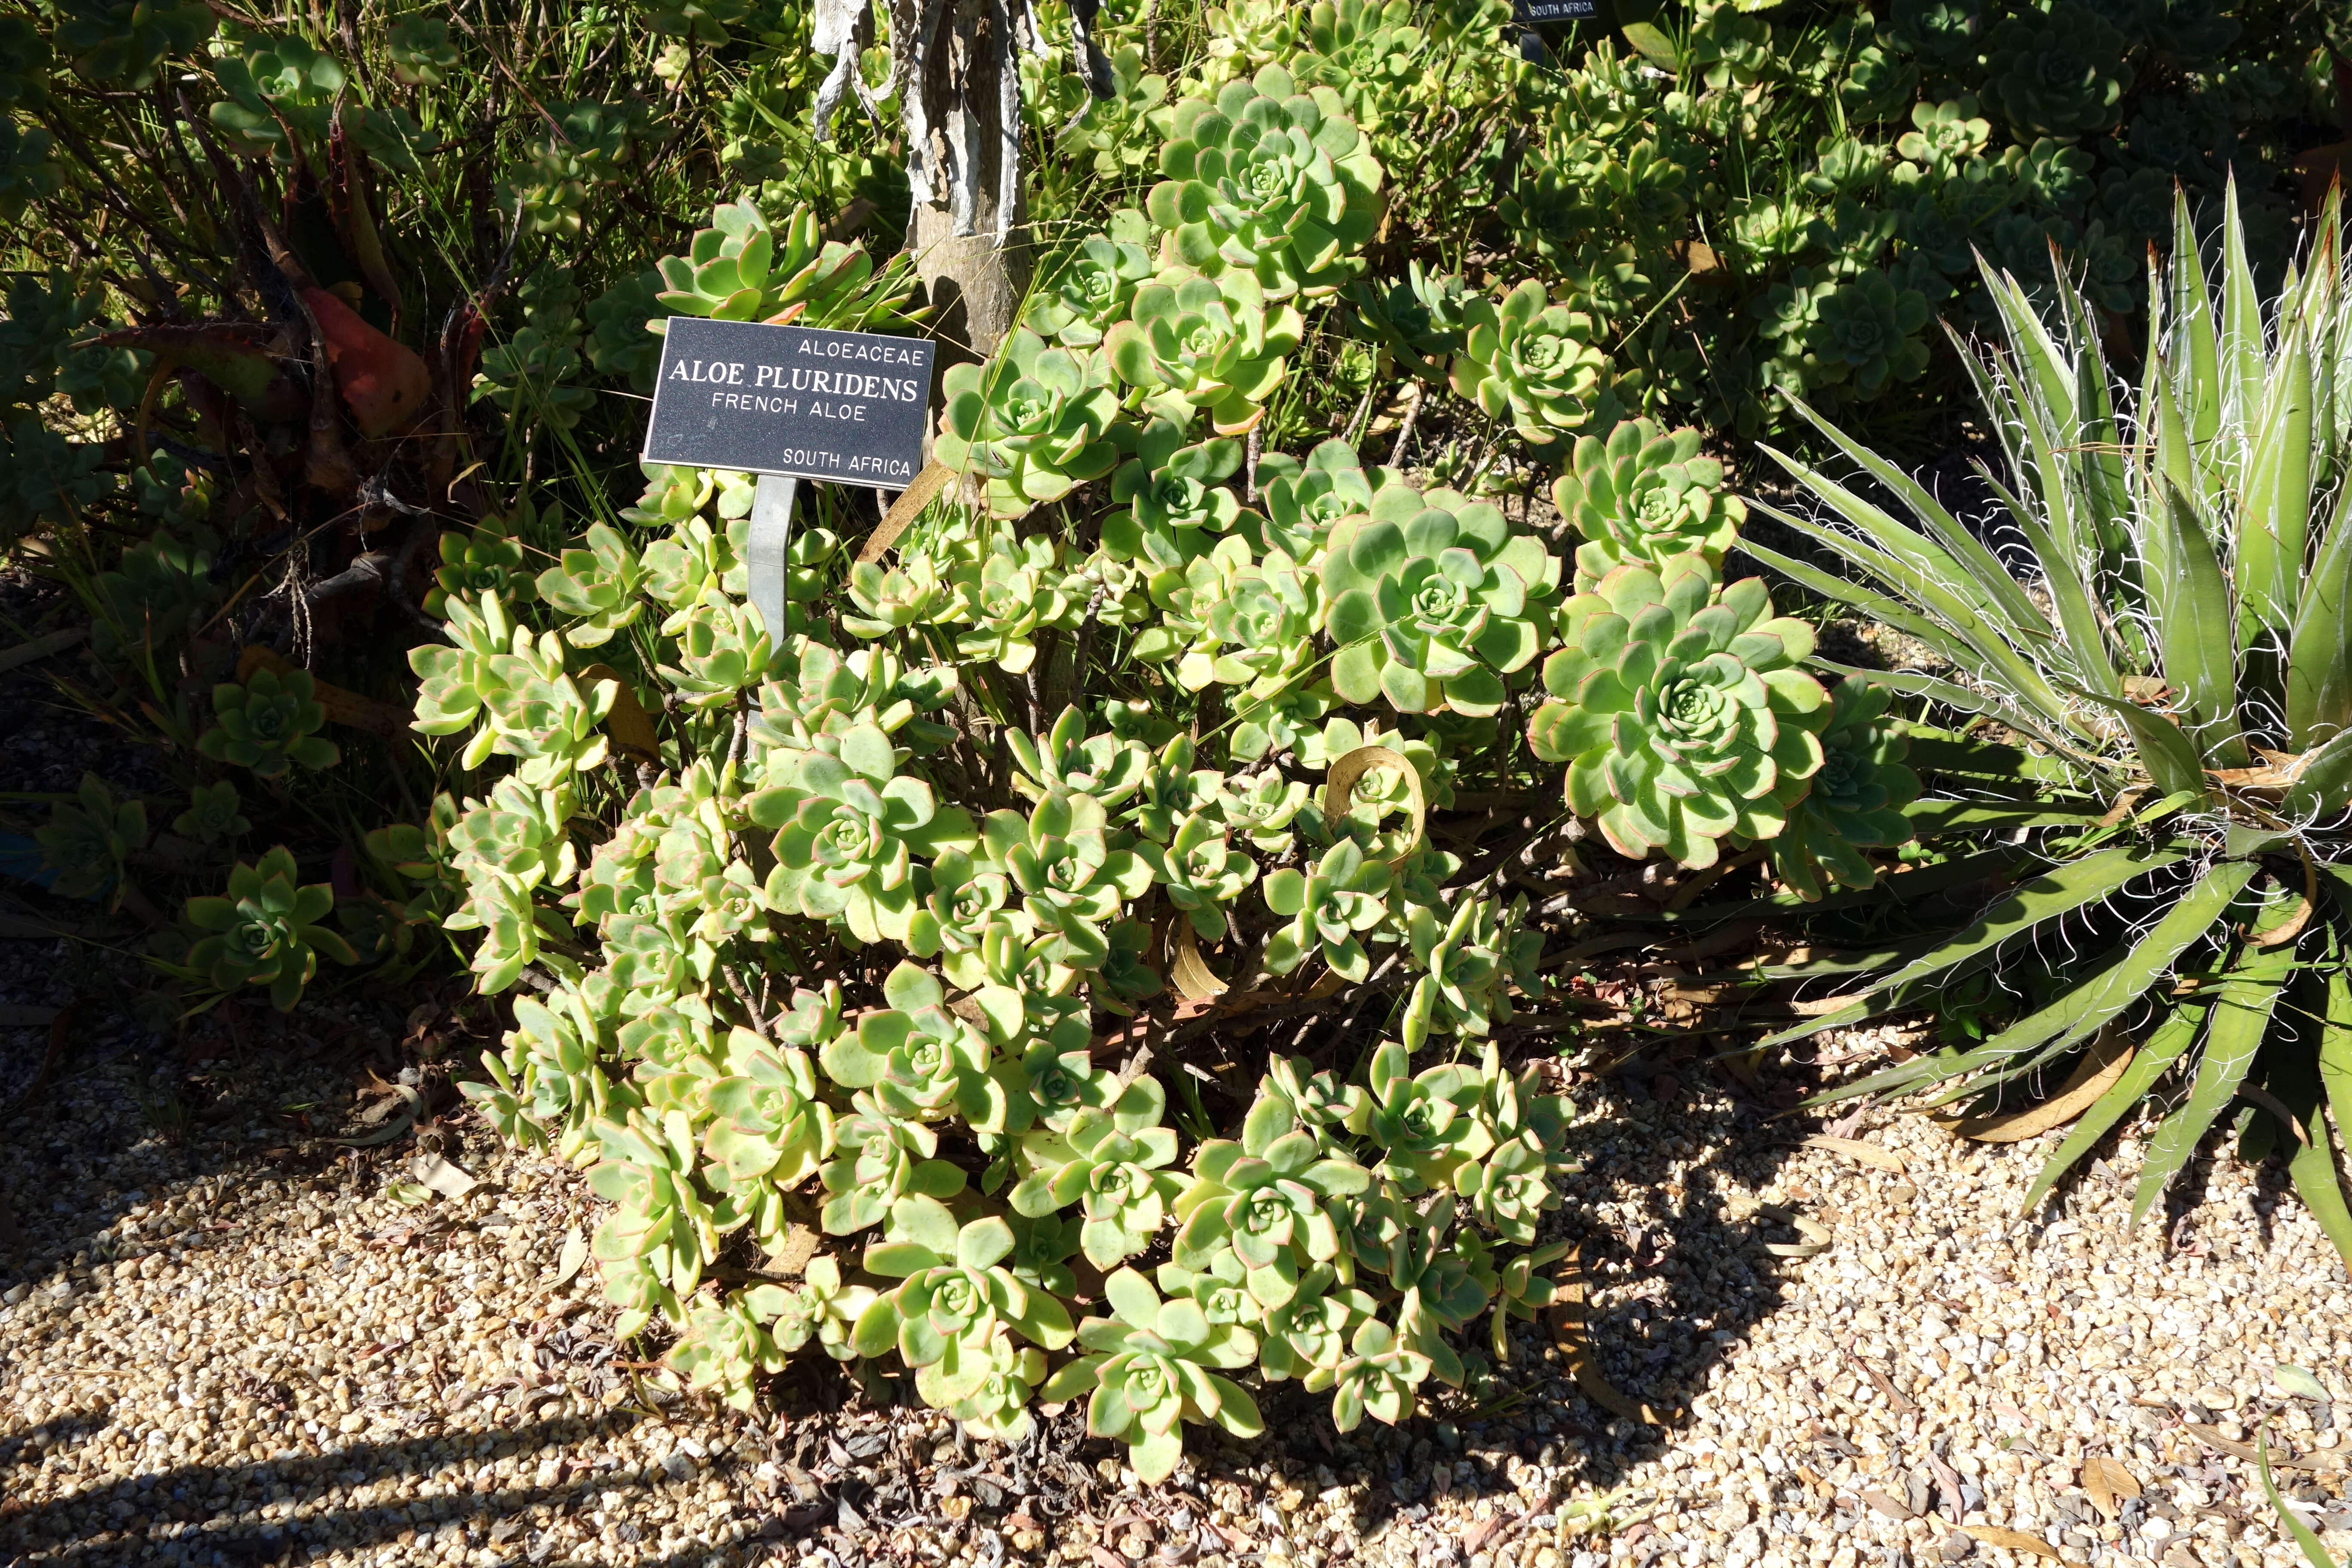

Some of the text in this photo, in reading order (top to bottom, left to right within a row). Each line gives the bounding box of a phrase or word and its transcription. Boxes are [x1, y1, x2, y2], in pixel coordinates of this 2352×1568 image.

[1531, 1, 1593, 16] SOUTH AFRICA
[798, 339, 924, 366] ALOEACEAE
[668, 359, 917, 402] ALOE PLURIDENS
[712, 392, 867, 422] FRENCH ALOE
[783, 448, 911, 477] SOUTH AFRICA
